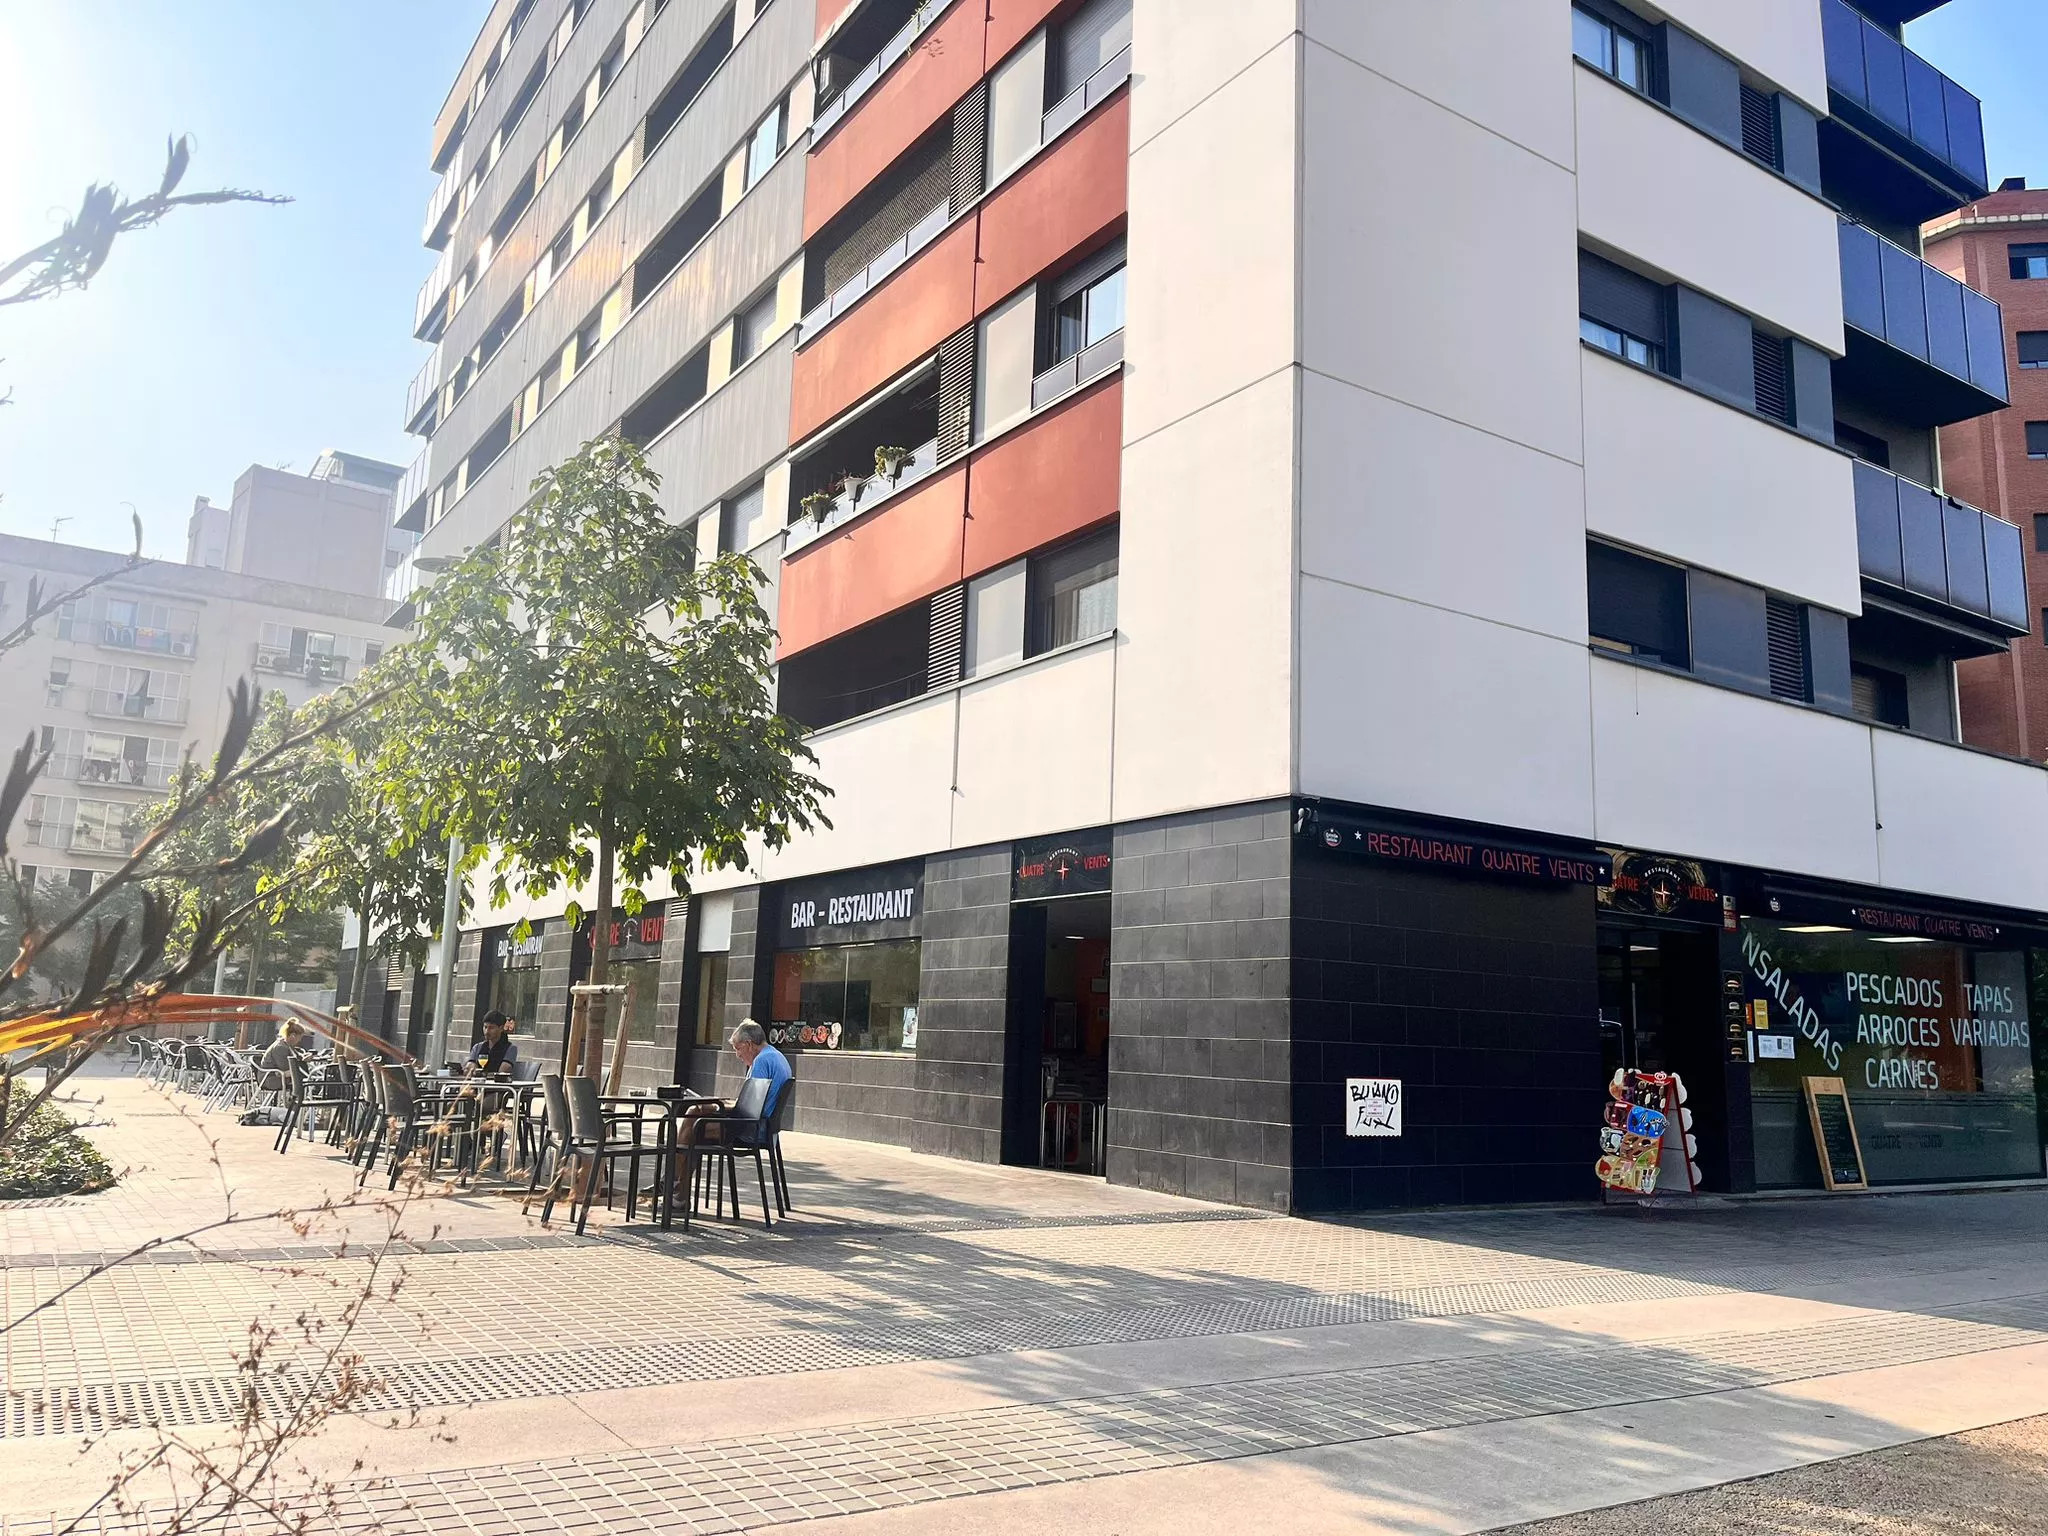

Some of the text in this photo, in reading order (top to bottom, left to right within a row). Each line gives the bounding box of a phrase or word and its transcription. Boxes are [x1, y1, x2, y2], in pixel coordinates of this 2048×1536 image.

[1019, 854, 1107, 878] QUATRE VENTS
[1367, 832, 1595, 883] RESTAURANT QUATRE VENTS
[1644, 865, 1681, 882] RESTAURANT
[791, 901, 815, 929] BAR
[828, 887, 914, 926] RESTAURANT
[1687, 885, 1716, 902] VENTS
[1858, 907, 1995, 941] RESTAURANT QUATRE VENTS
[497, 939, 509, 957] BAR
[1741, 931, 1844, 1072] NSALADAS
[1846, 971, 1943, 1009] PESCADOS
[1962, 983, 2013, 1013] TAPAS
[1856, 1013, 1940, 1048] ARROCES
[1949, 1017, 2030, 1048] VARIADAS
[1865, 1057, 1939, 1091] CARNES
